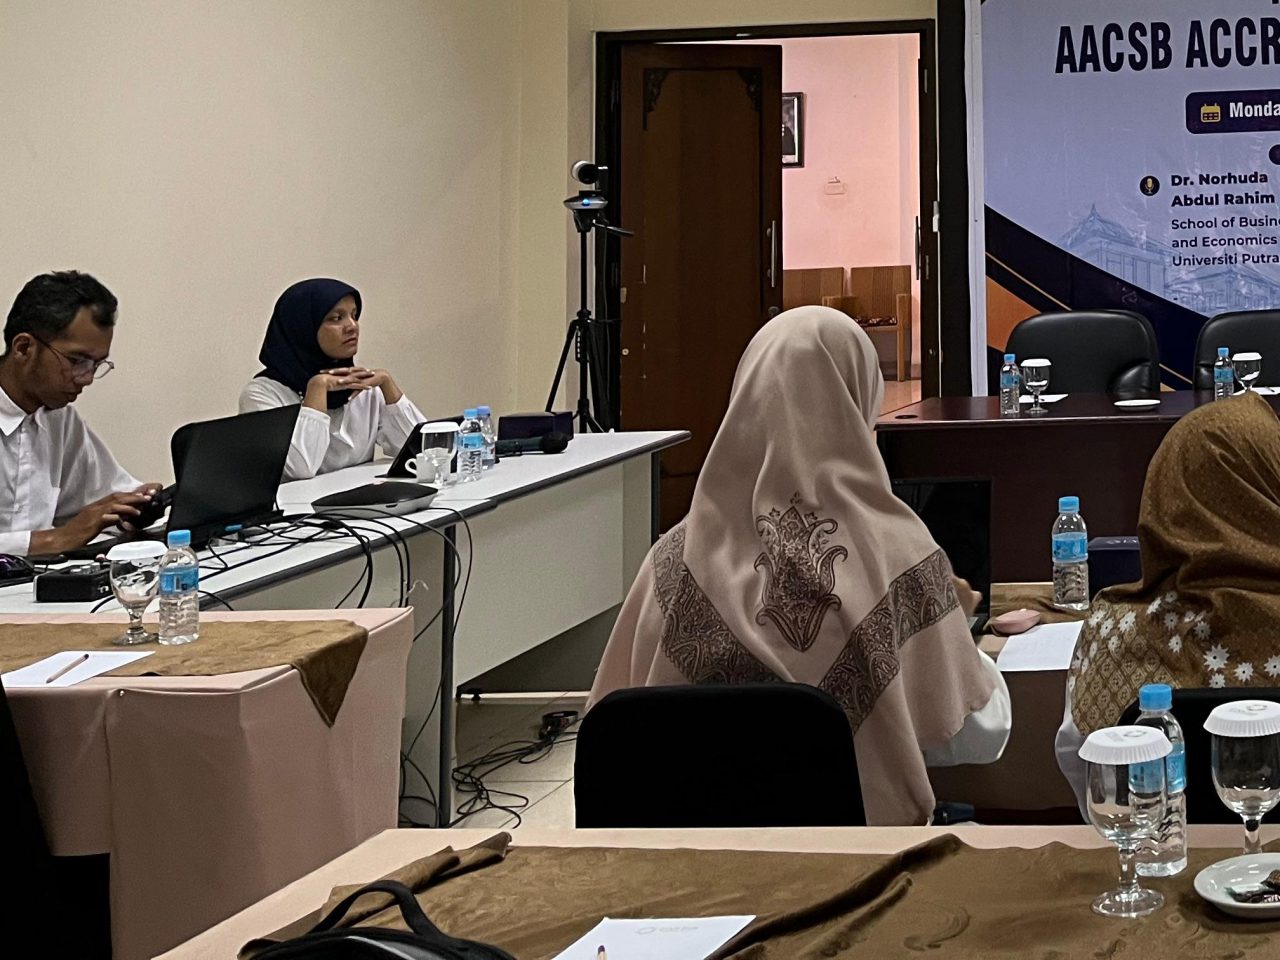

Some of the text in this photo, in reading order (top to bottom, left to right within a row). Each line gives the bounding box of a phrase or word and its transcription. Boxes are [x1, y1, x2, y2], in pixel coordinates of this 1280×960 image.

[1055, 21, 1173, 74] AACSB
[1171, 171, 1268, 187] Dr. Norhuda
[1171, 191, 1275, 207] Abdul Rahim
[1171, 217, 1218, 230] School
[1222, 216, 1236, 228] of
[1171, 234, 1278, 249] and Economics
[1171, 253, 1239, 267] Universiti
[1242, 252, 1280, 265] Putra
